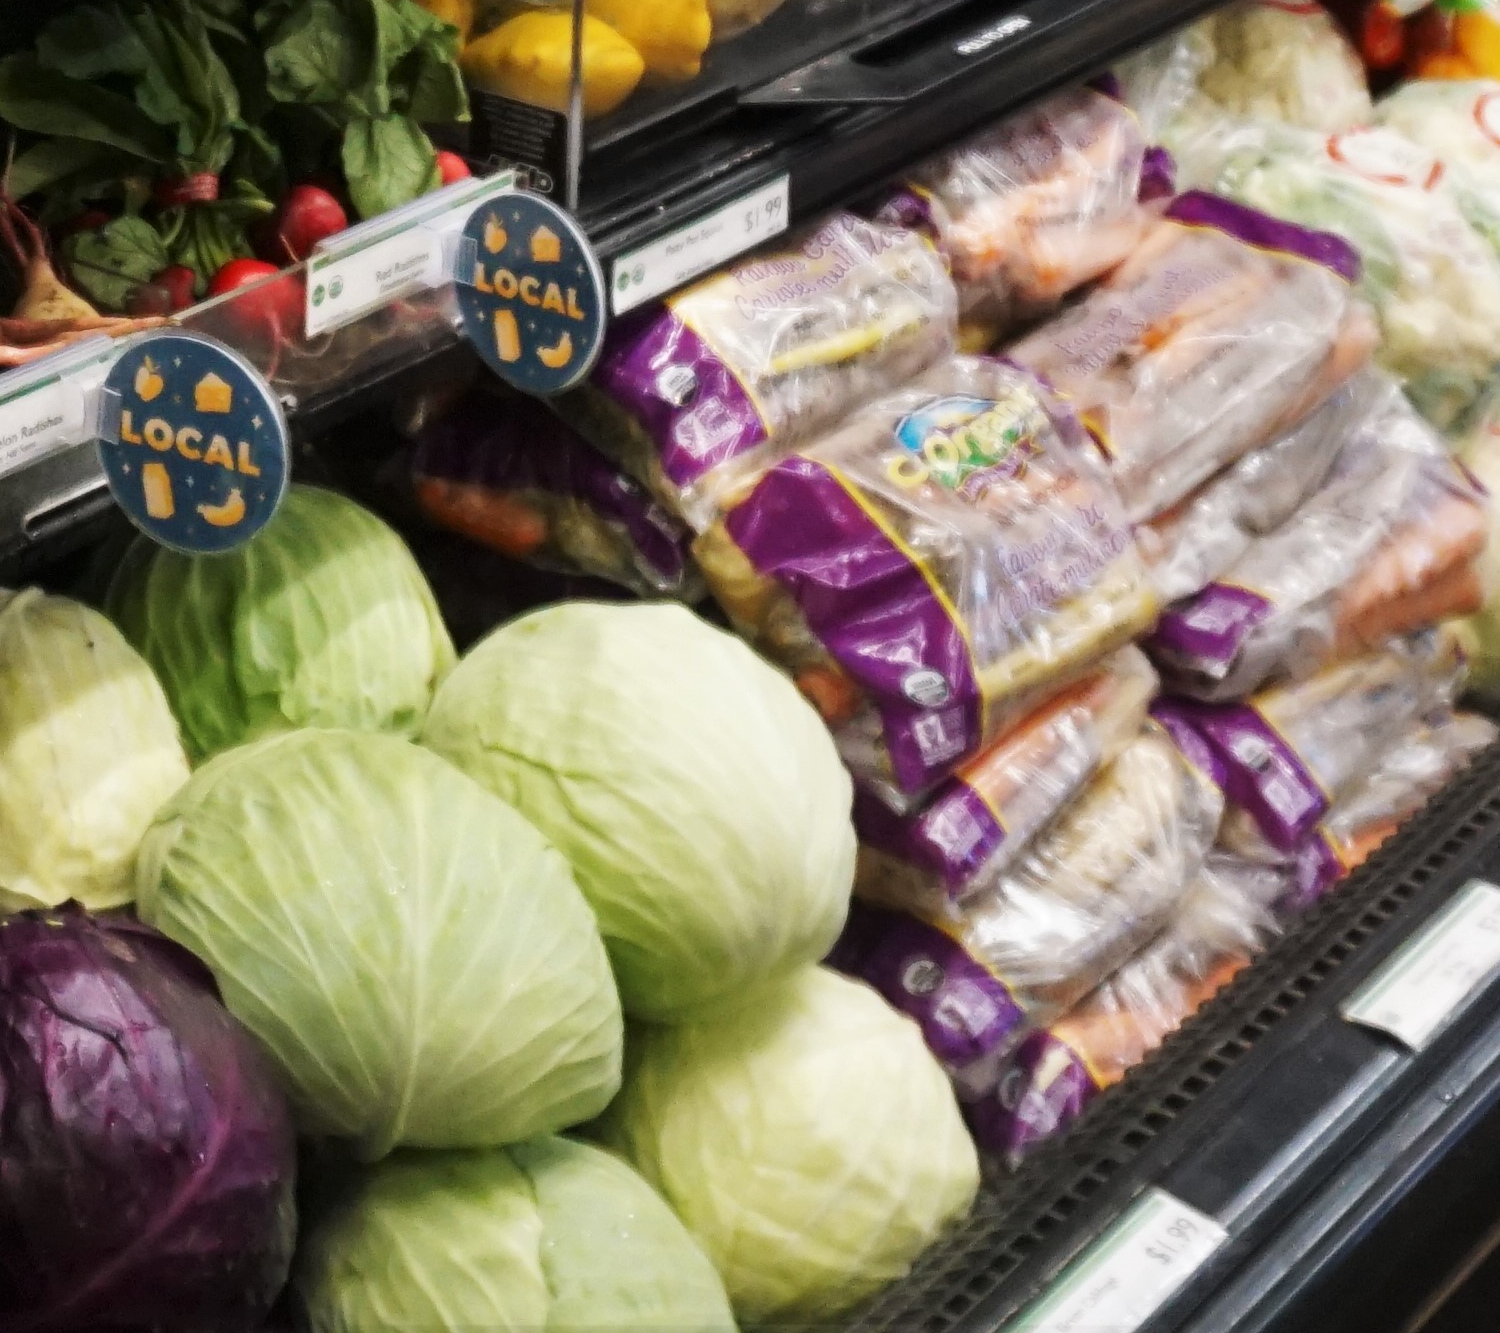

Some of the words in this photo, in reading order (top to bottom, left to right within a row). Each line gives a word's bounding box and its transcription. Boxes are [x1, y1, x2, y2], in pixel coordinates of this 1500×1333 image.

[744, 195, 782, 234] $1.99
[375, 262, 396, 283] Red
[398, 250, 430, 276] Radishes
[475, 261, 585, 321] LOCAL
[20, 413, 64, 443] Radishes
[121, 409, 261, 477] LOCAL
[1146, 1216, 1195, 1267] $1.99
